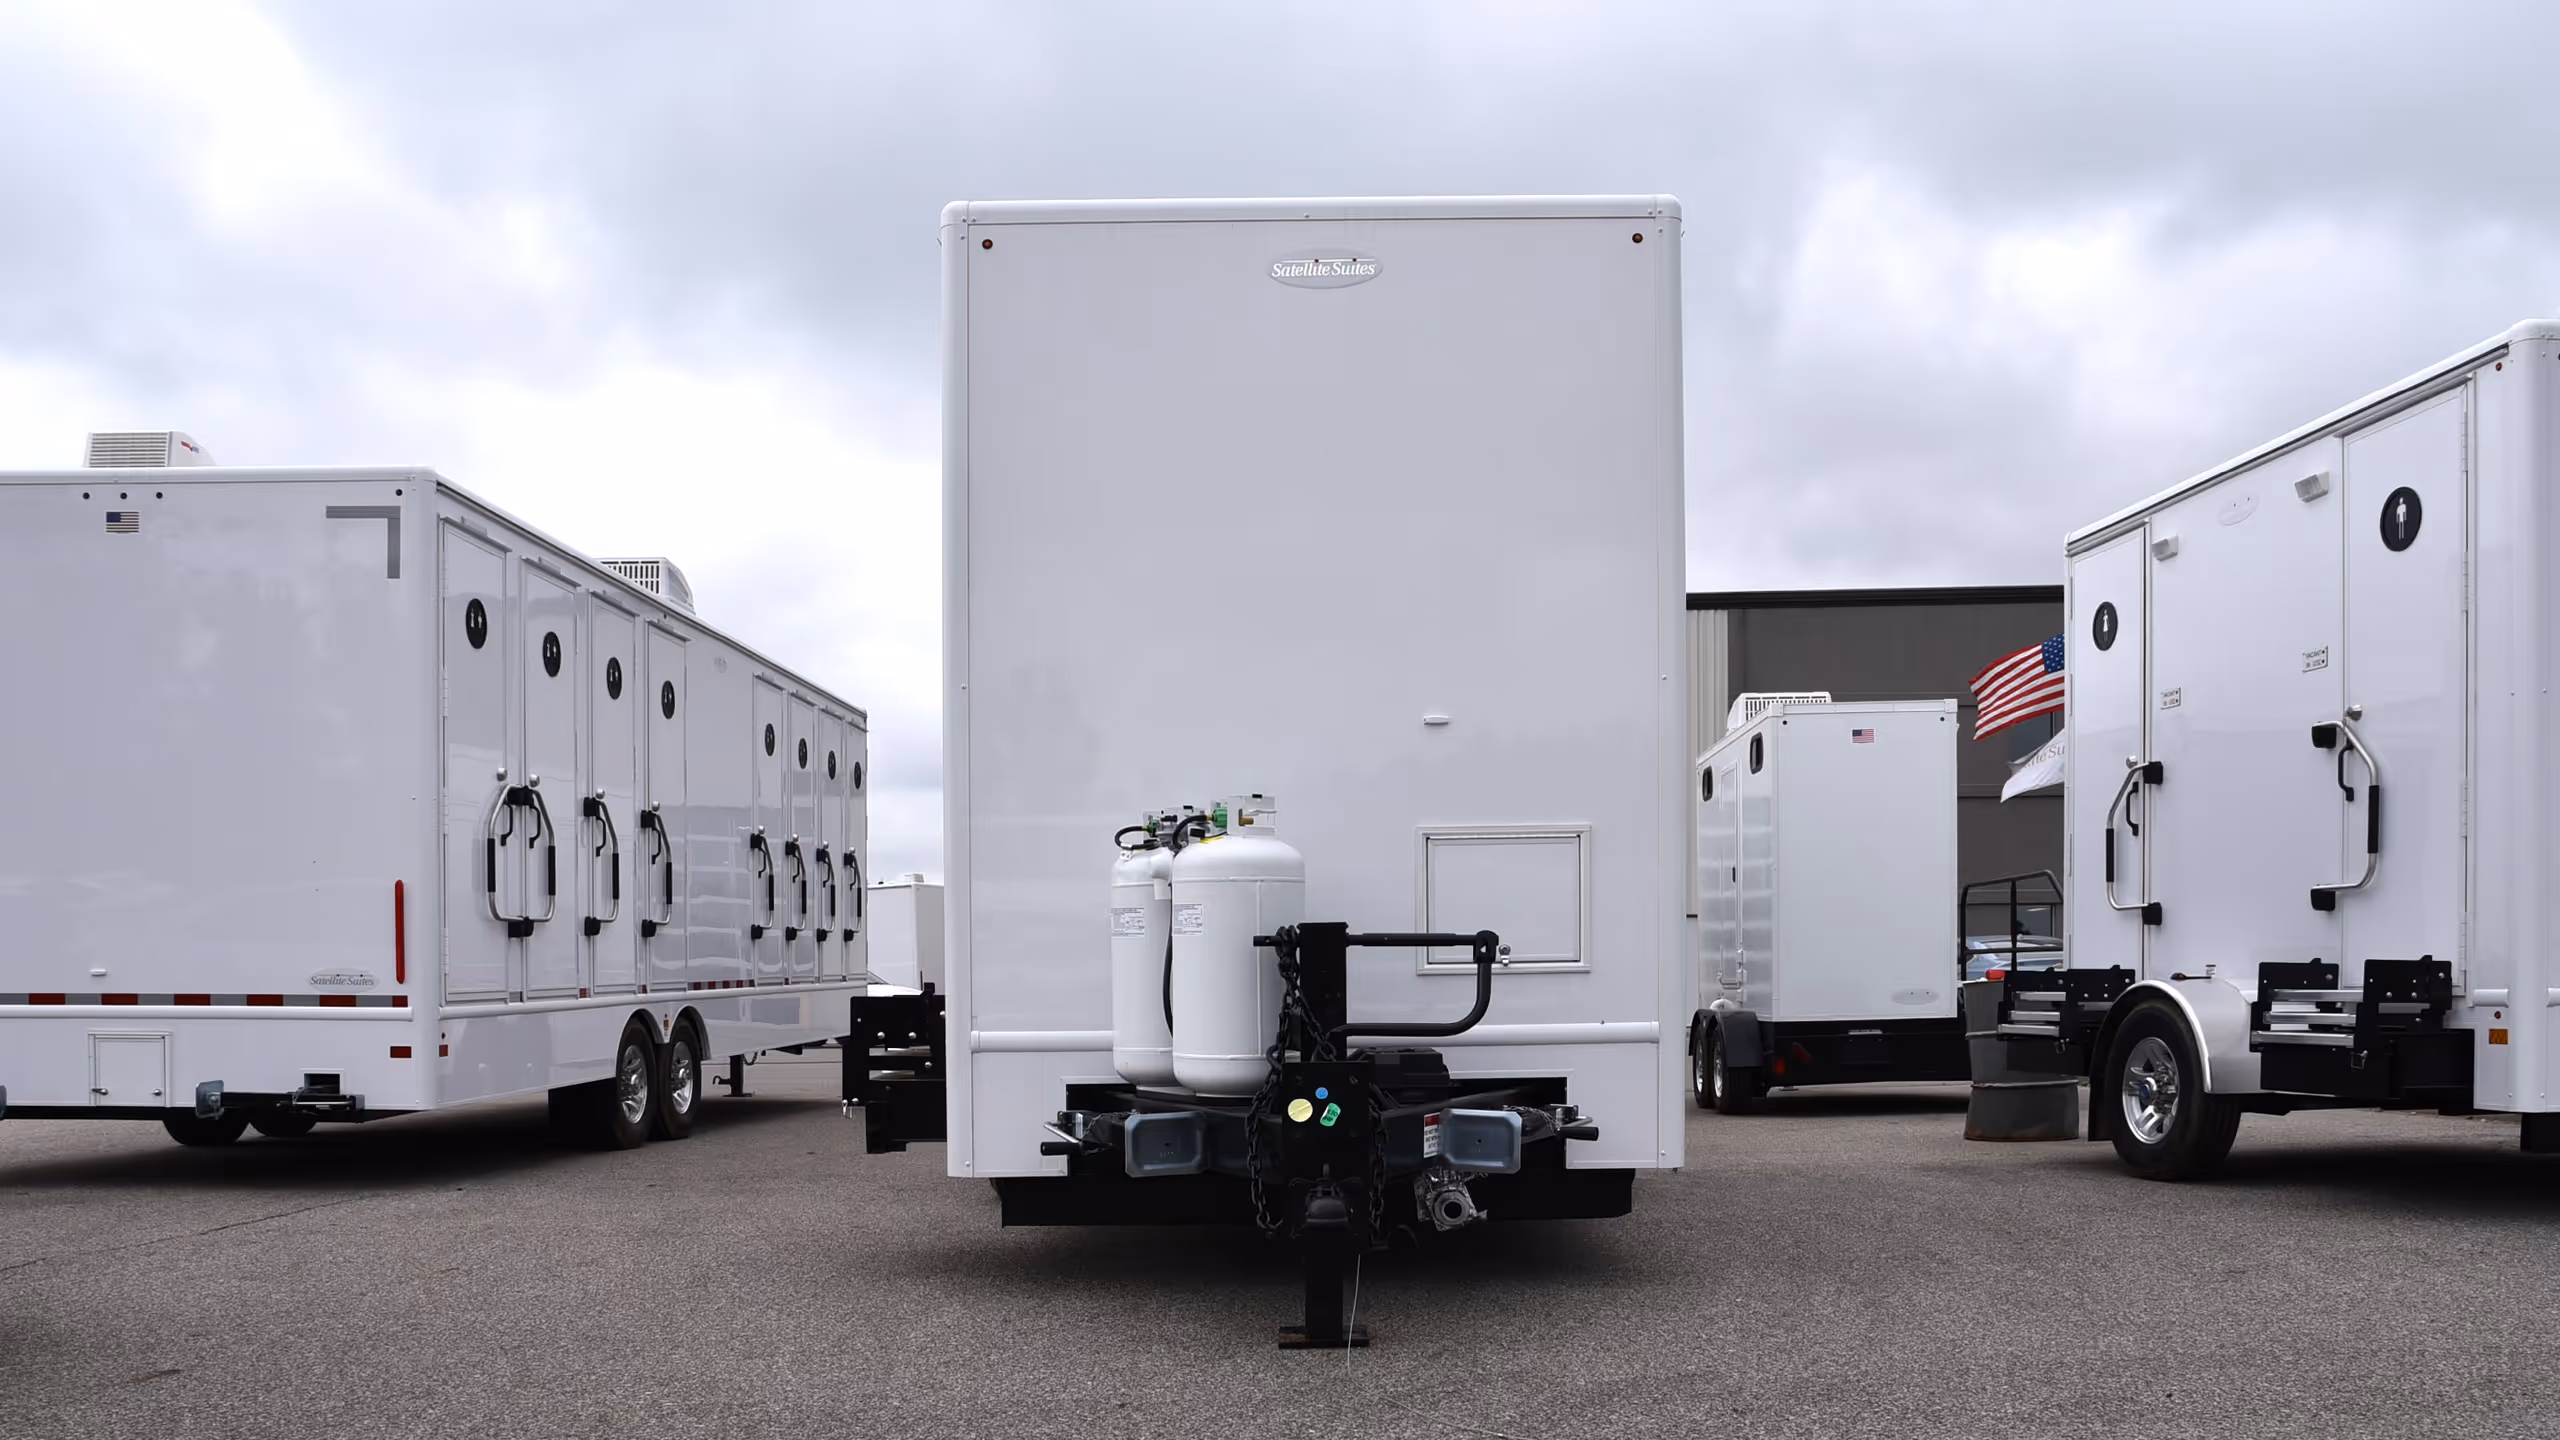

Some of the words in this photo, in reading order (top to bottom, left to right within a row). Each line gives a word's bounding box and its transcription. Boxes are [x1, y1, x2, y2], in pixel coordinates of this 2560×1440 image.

[1271, 260, 1330, 278] Satellite
[1331, 259, 1377, 277] Suites
[310, 974, 345, 986] Satellite
[346, 974, 375, 986] Suites
